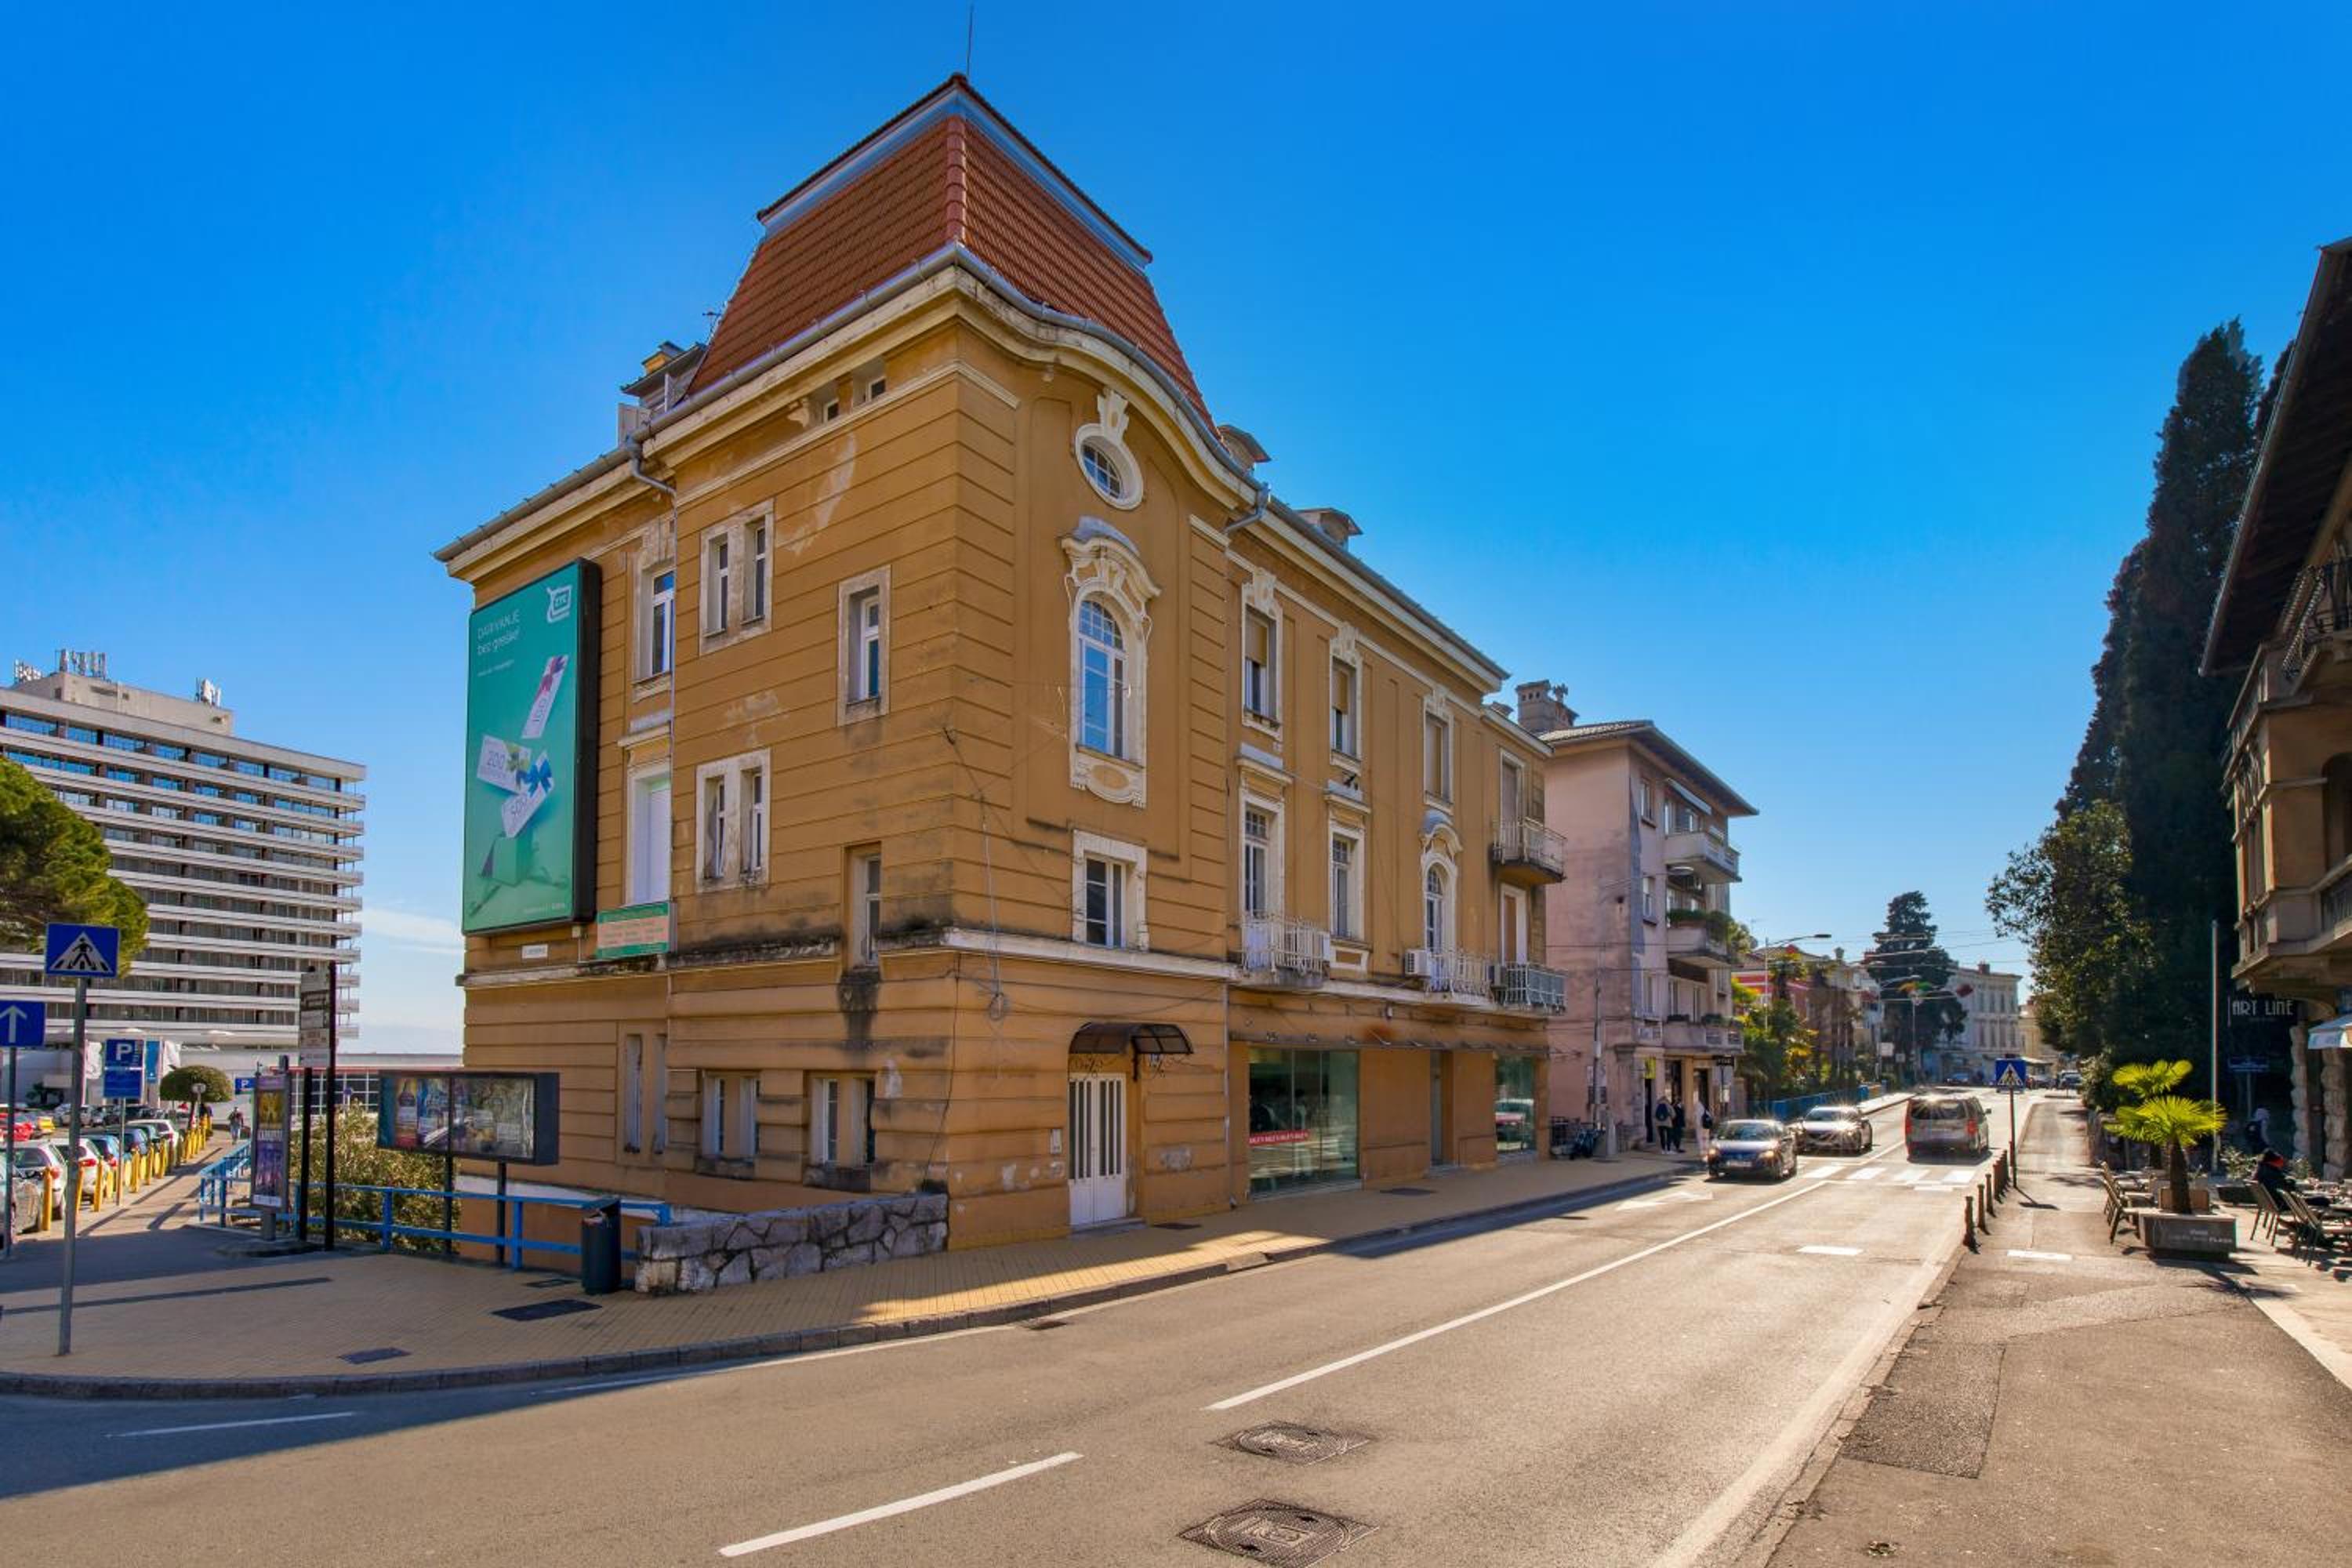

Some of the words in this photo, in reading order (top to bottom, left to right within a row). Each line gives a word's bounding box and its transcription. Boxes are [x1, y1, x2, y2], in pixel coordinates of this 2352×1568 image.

[2232, 1000, 2258, 1016] ART
[2264, 1000, 2294, 1016] LINE
[116, 1044, 132, 1061] P
[241, 1080, 249, 1090] P
